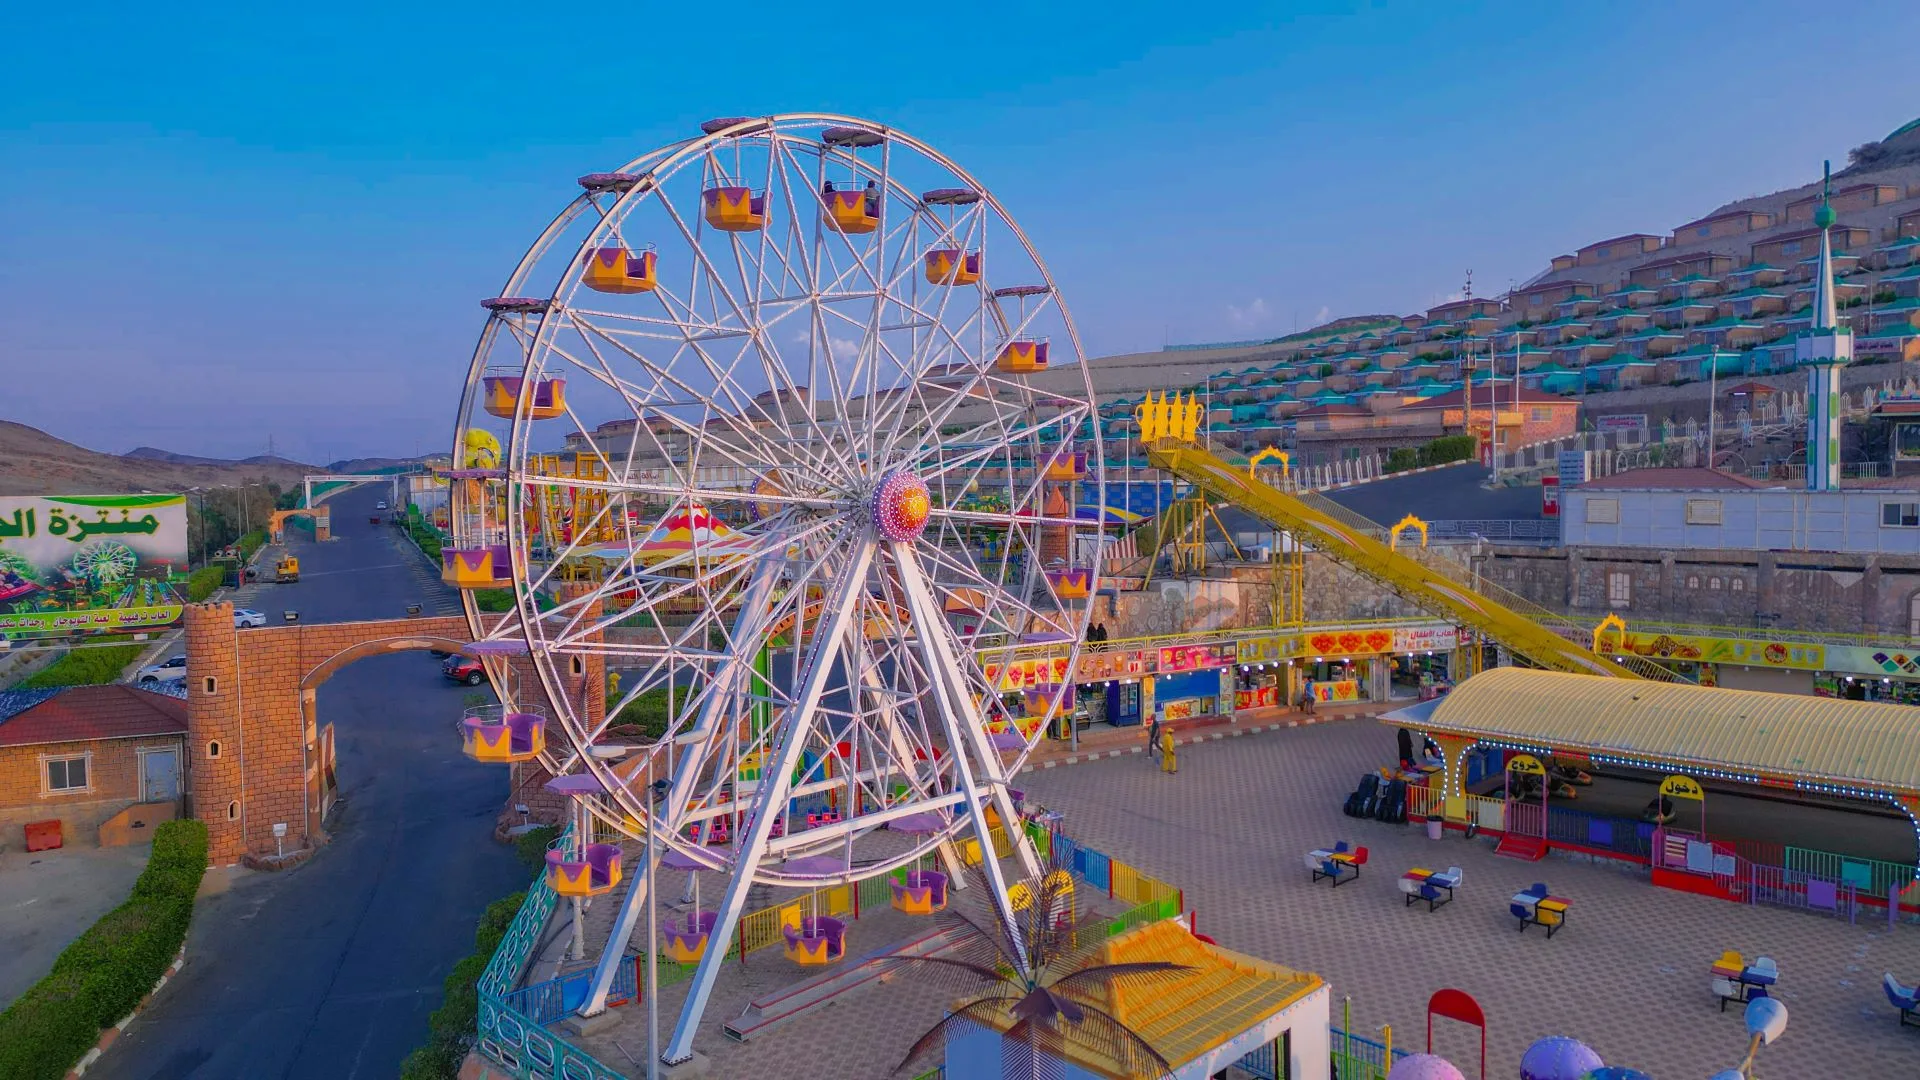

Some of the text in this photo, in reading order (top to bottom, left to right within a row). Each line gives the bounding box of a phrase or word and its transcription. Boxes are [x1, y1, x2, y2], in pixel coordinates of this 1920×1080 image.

[48, 508, 160, 543] منتزة
[19, 618, 45, 629] وحدات
[94, 614, 110, 623] لعبة
[118, 611, 148, 624] ترفيهية
[1511, 760, 1540, 770] خروج
[1665, 781, 1698, 794] دخول
